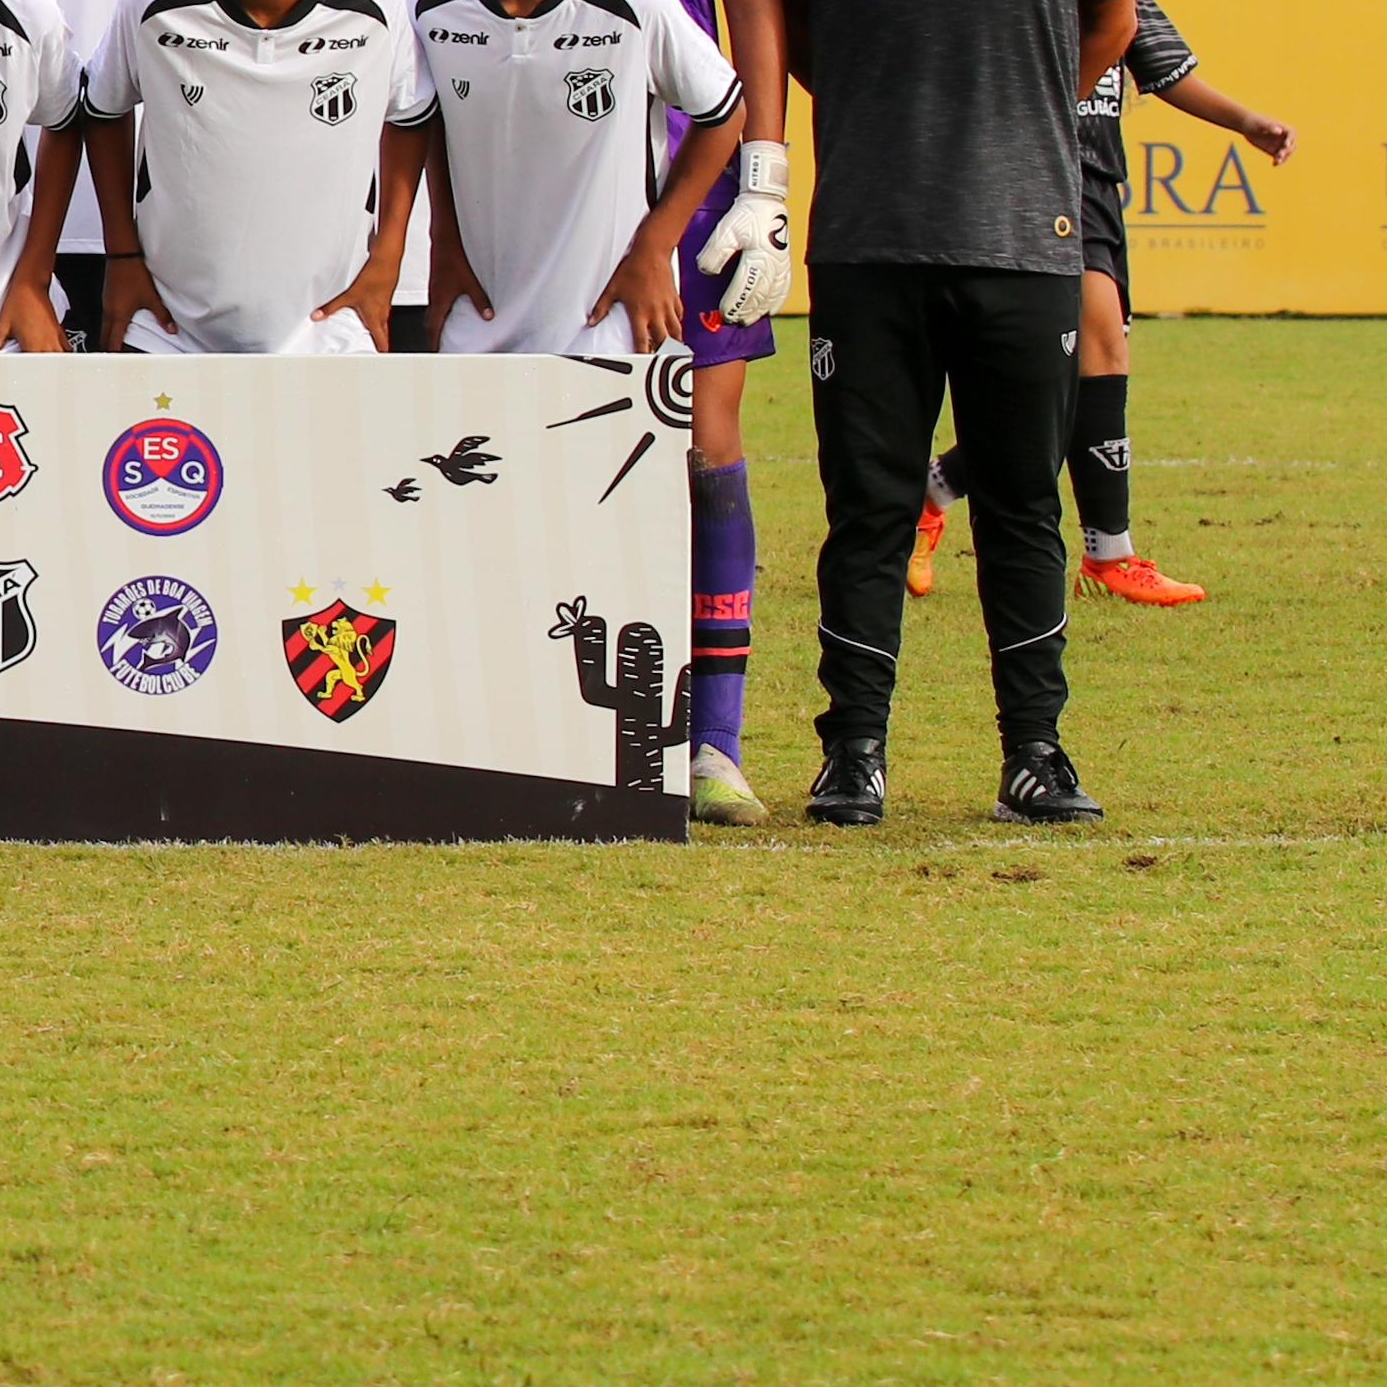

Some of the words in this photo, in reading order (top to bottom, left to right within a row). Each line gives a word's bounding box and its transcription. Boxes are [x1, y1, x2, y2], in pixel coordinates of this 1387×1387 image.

[186, 38, 230, 51] zenir
[328, 34, 368, 50] zenir
[451, 31, 489, 45] zenir
[581, 30, 623, 47] zenir
[728, 266, 759, 317] RAPTOR
[146, 579, 162, 595] DE
[162, 580, 186, 601] BOA
[109, 659, 162, 694] FUTEBOL
[162, 662, 200, 694] CLUBE
